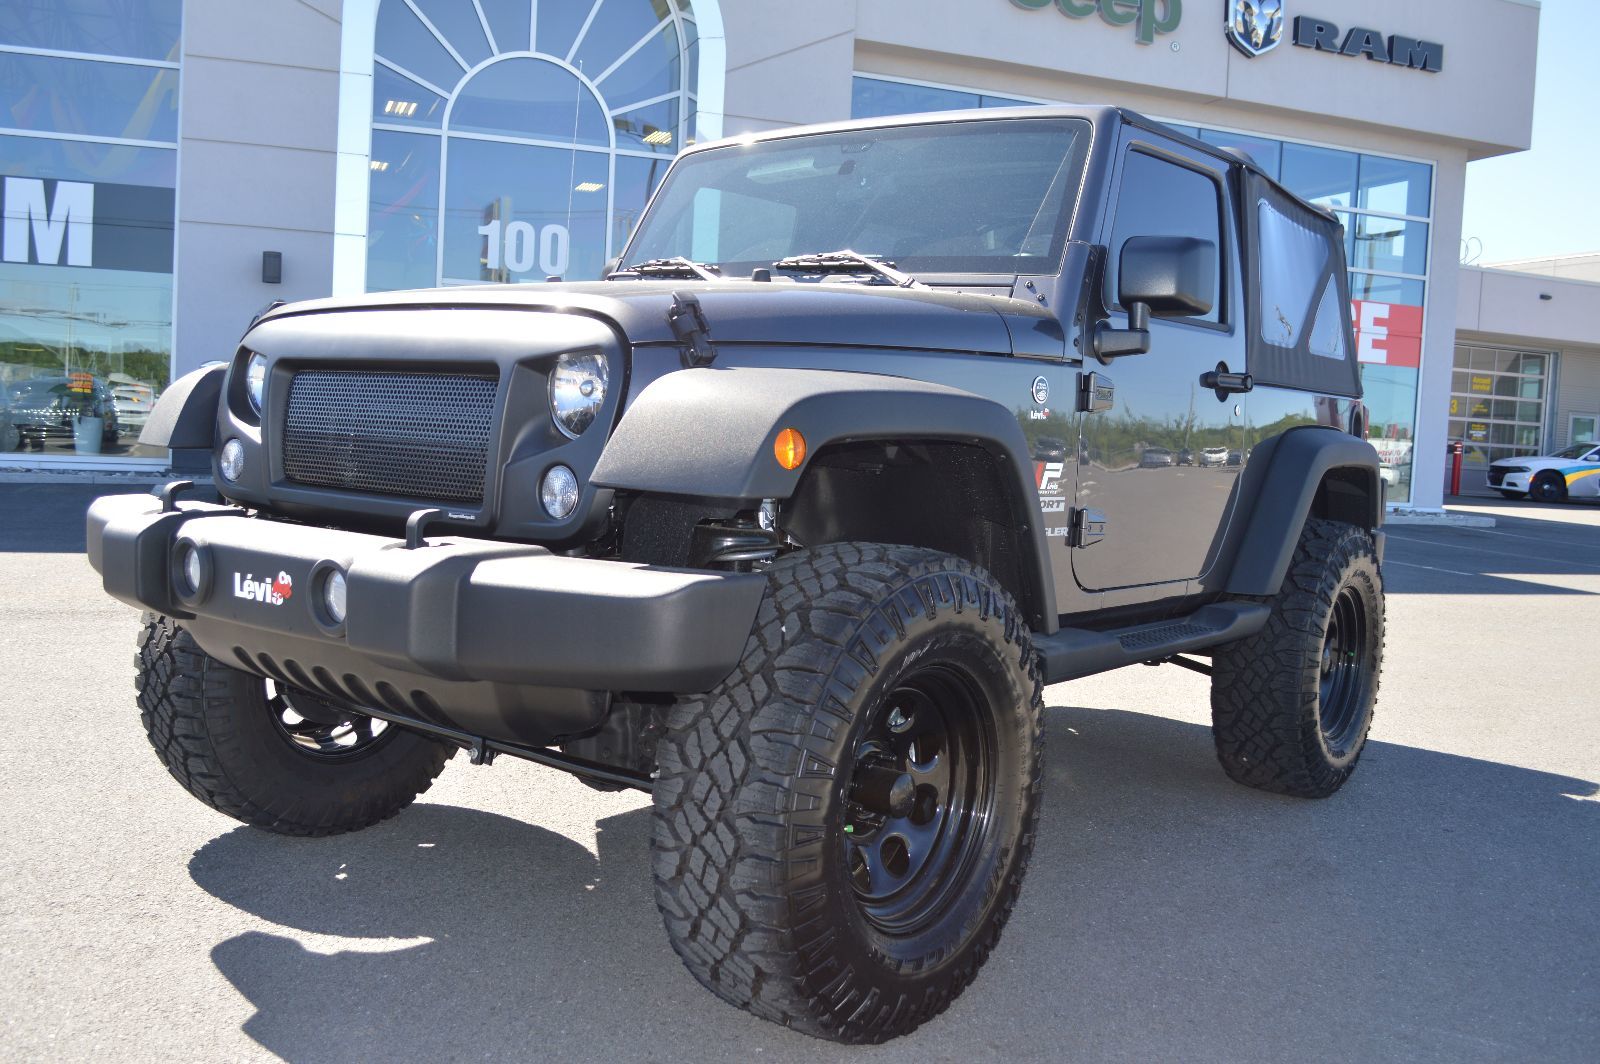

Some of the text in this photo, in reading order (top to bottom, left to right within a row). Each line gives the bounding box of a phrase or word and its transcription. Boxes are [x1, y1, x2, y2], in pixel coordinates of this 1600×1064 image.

[1292, 15, 1443, 73] RAM
[3, 176, 94, 267] M
[478, 219, 570, 276] 100
[1351, 302, 1390, 364] E
